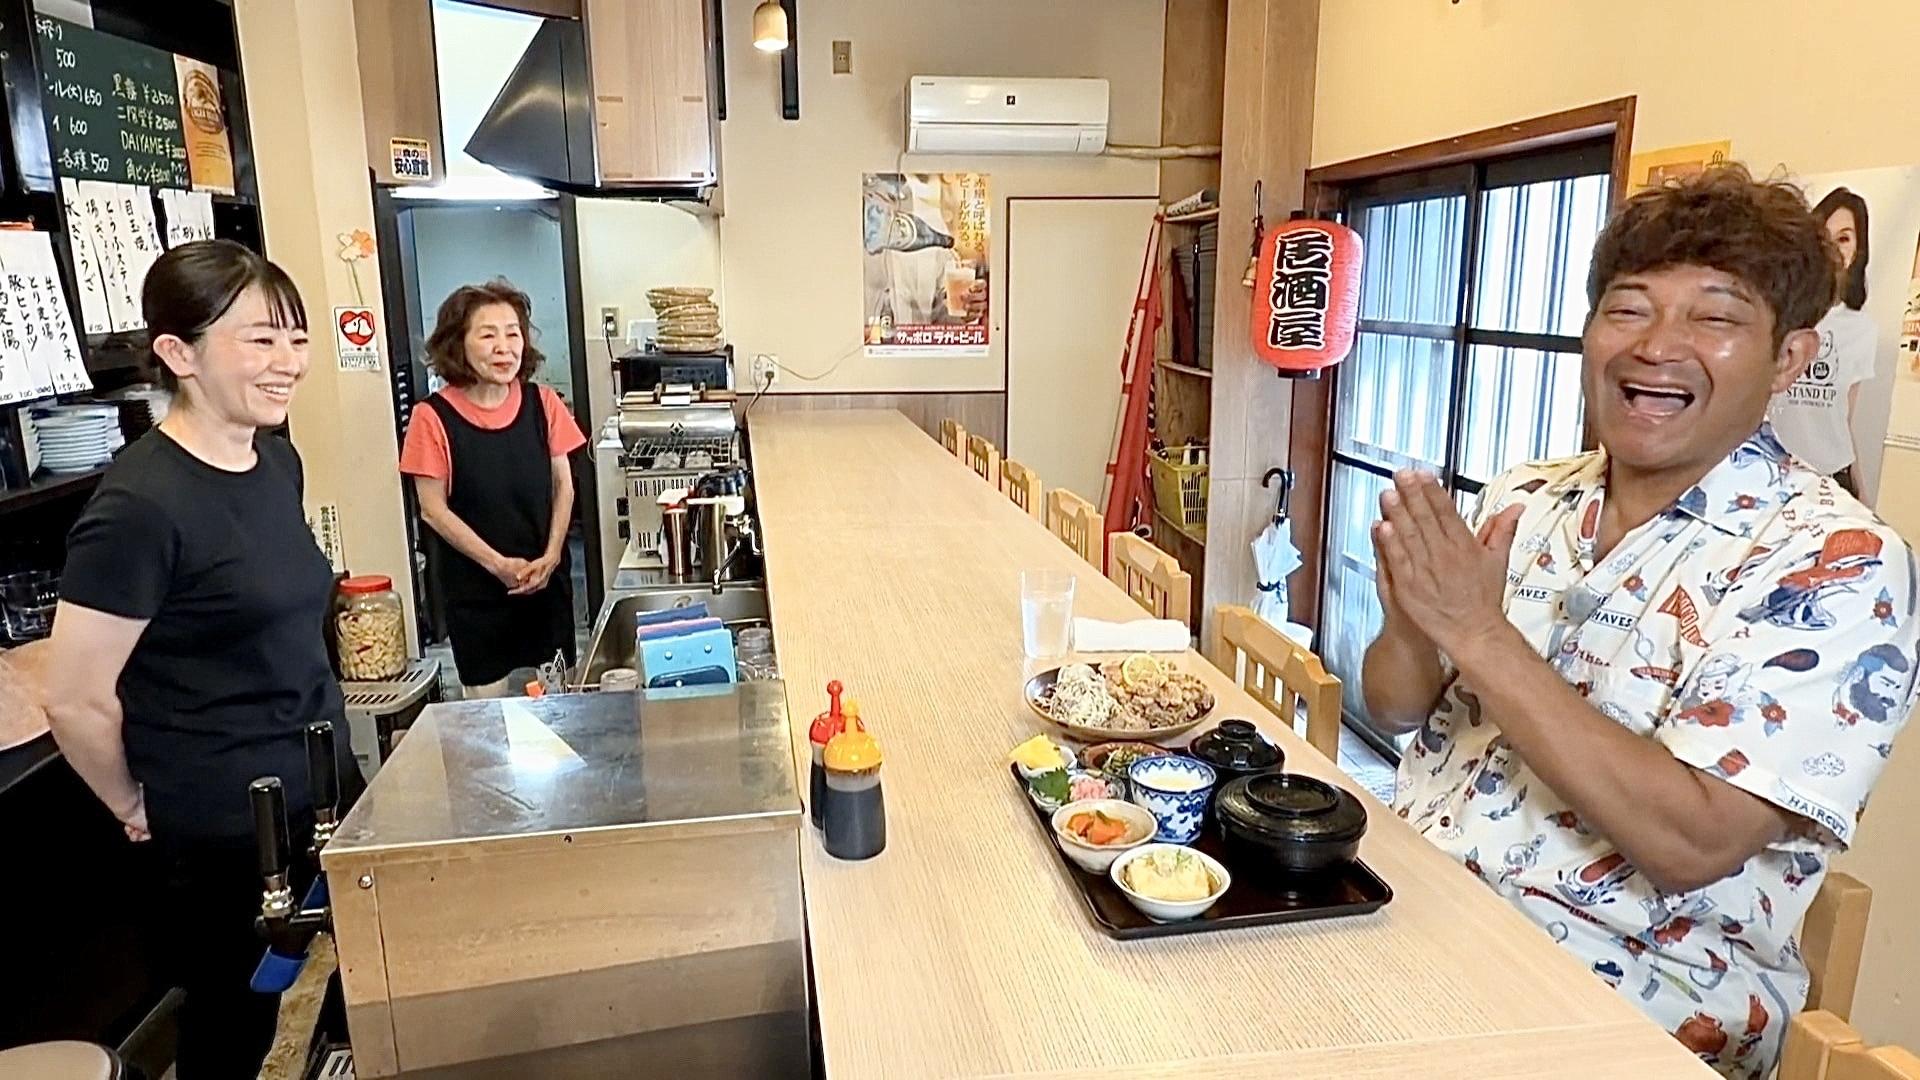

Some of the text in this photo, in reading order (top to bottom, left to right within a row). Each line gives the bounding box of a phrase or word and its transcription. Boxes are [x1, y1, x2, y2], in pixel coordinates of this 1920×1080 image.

[56, 48, 76, 68] 500
[84, 87, 103, 106] 650
[69, 116, 88, 136] 600
[121, 130, 164, 156] DAIYAME
[90, 152, 110, 174] 500
[1269, 229, 1333, 348] 居酒屋
[1786, 386, 1836, 401] STAND UP
[1788, 795, 1846, 836] HAIRCUT
